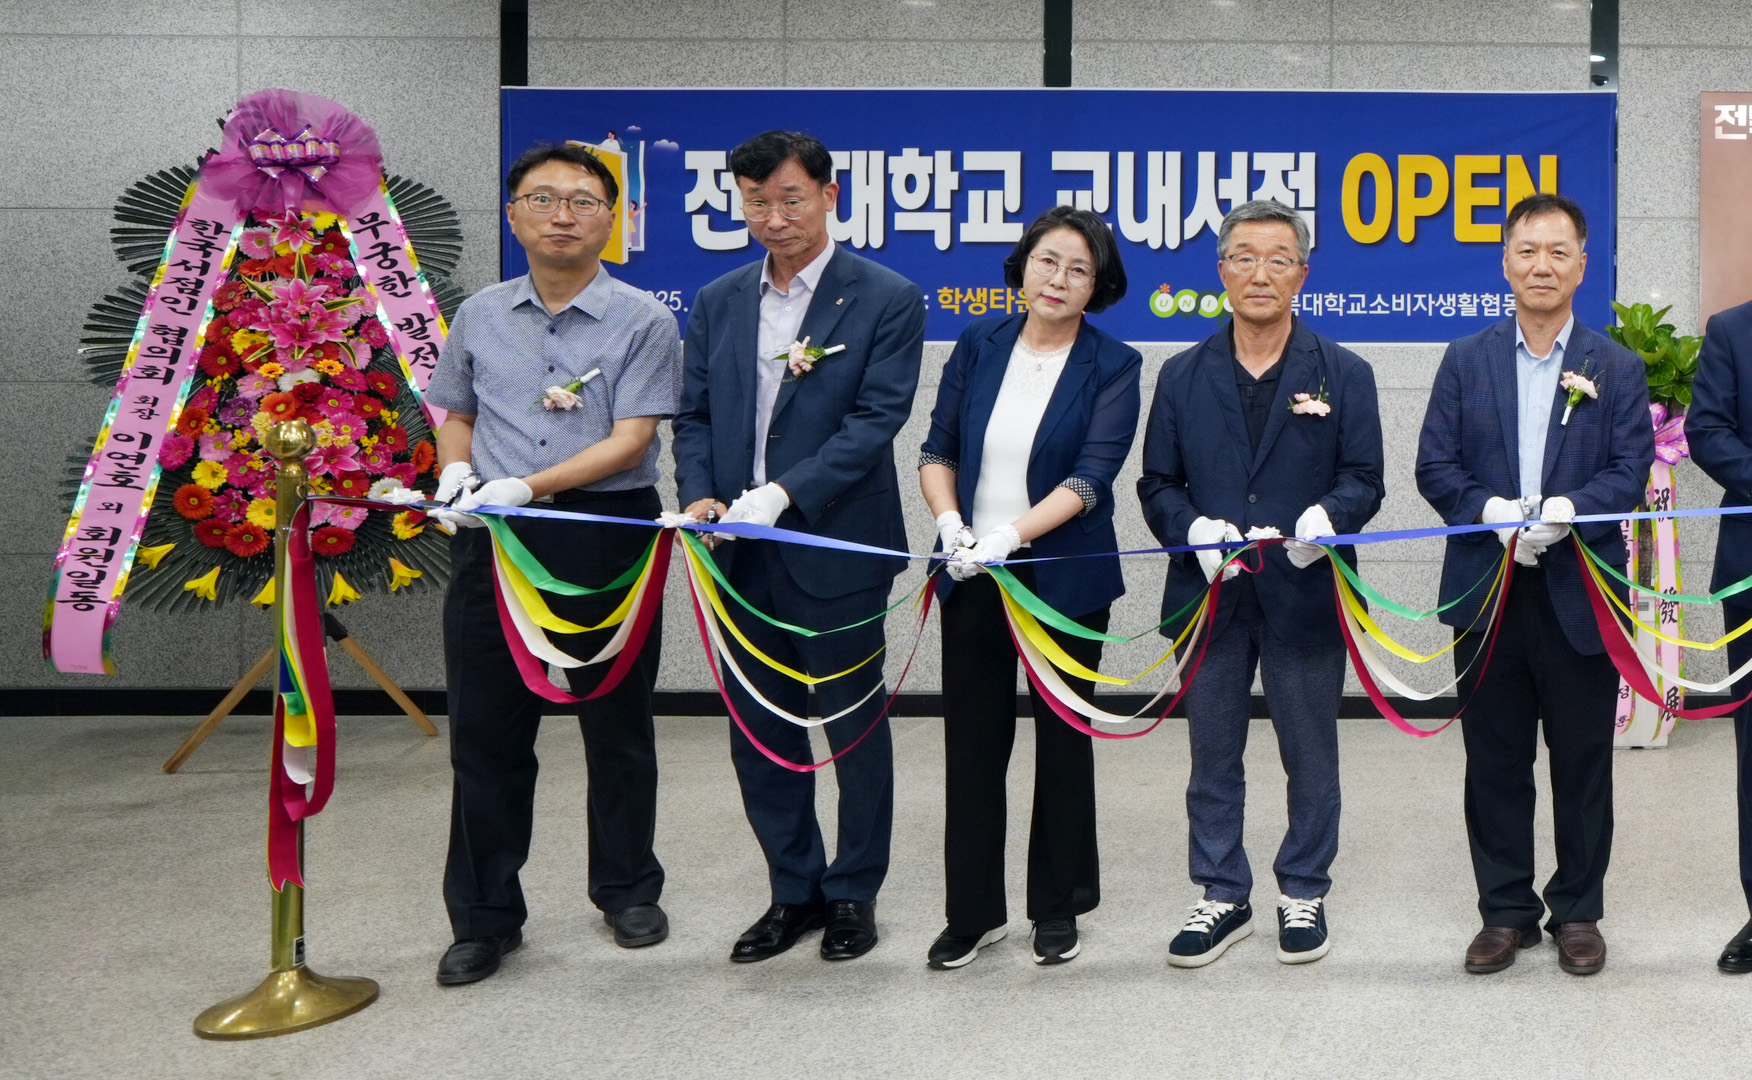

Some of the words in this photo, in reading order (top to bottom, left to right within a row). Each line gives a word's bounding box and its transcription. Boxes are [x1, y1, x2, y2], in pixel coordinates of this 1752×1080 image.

[685, 148, 1023, 250] 전대학교
[1051, 151, 1316, 250] 교내서점
[1341, 153, 1557, 243] OPEN
[160, 218, 232, 316] 한국서점인
[351, 212, 416, 298] 무궁한
[394, 312, 440, 392] 발전
[937, 286, 1031, 315] 학생타운
[132, 323, 189, 386] 협의회
[130, 395, 160, 420] 회장
[94, 432, 153, 490] 이연호
[96, 501, 123, 515] 외
[56, 526, 123, 612] 회원일동
